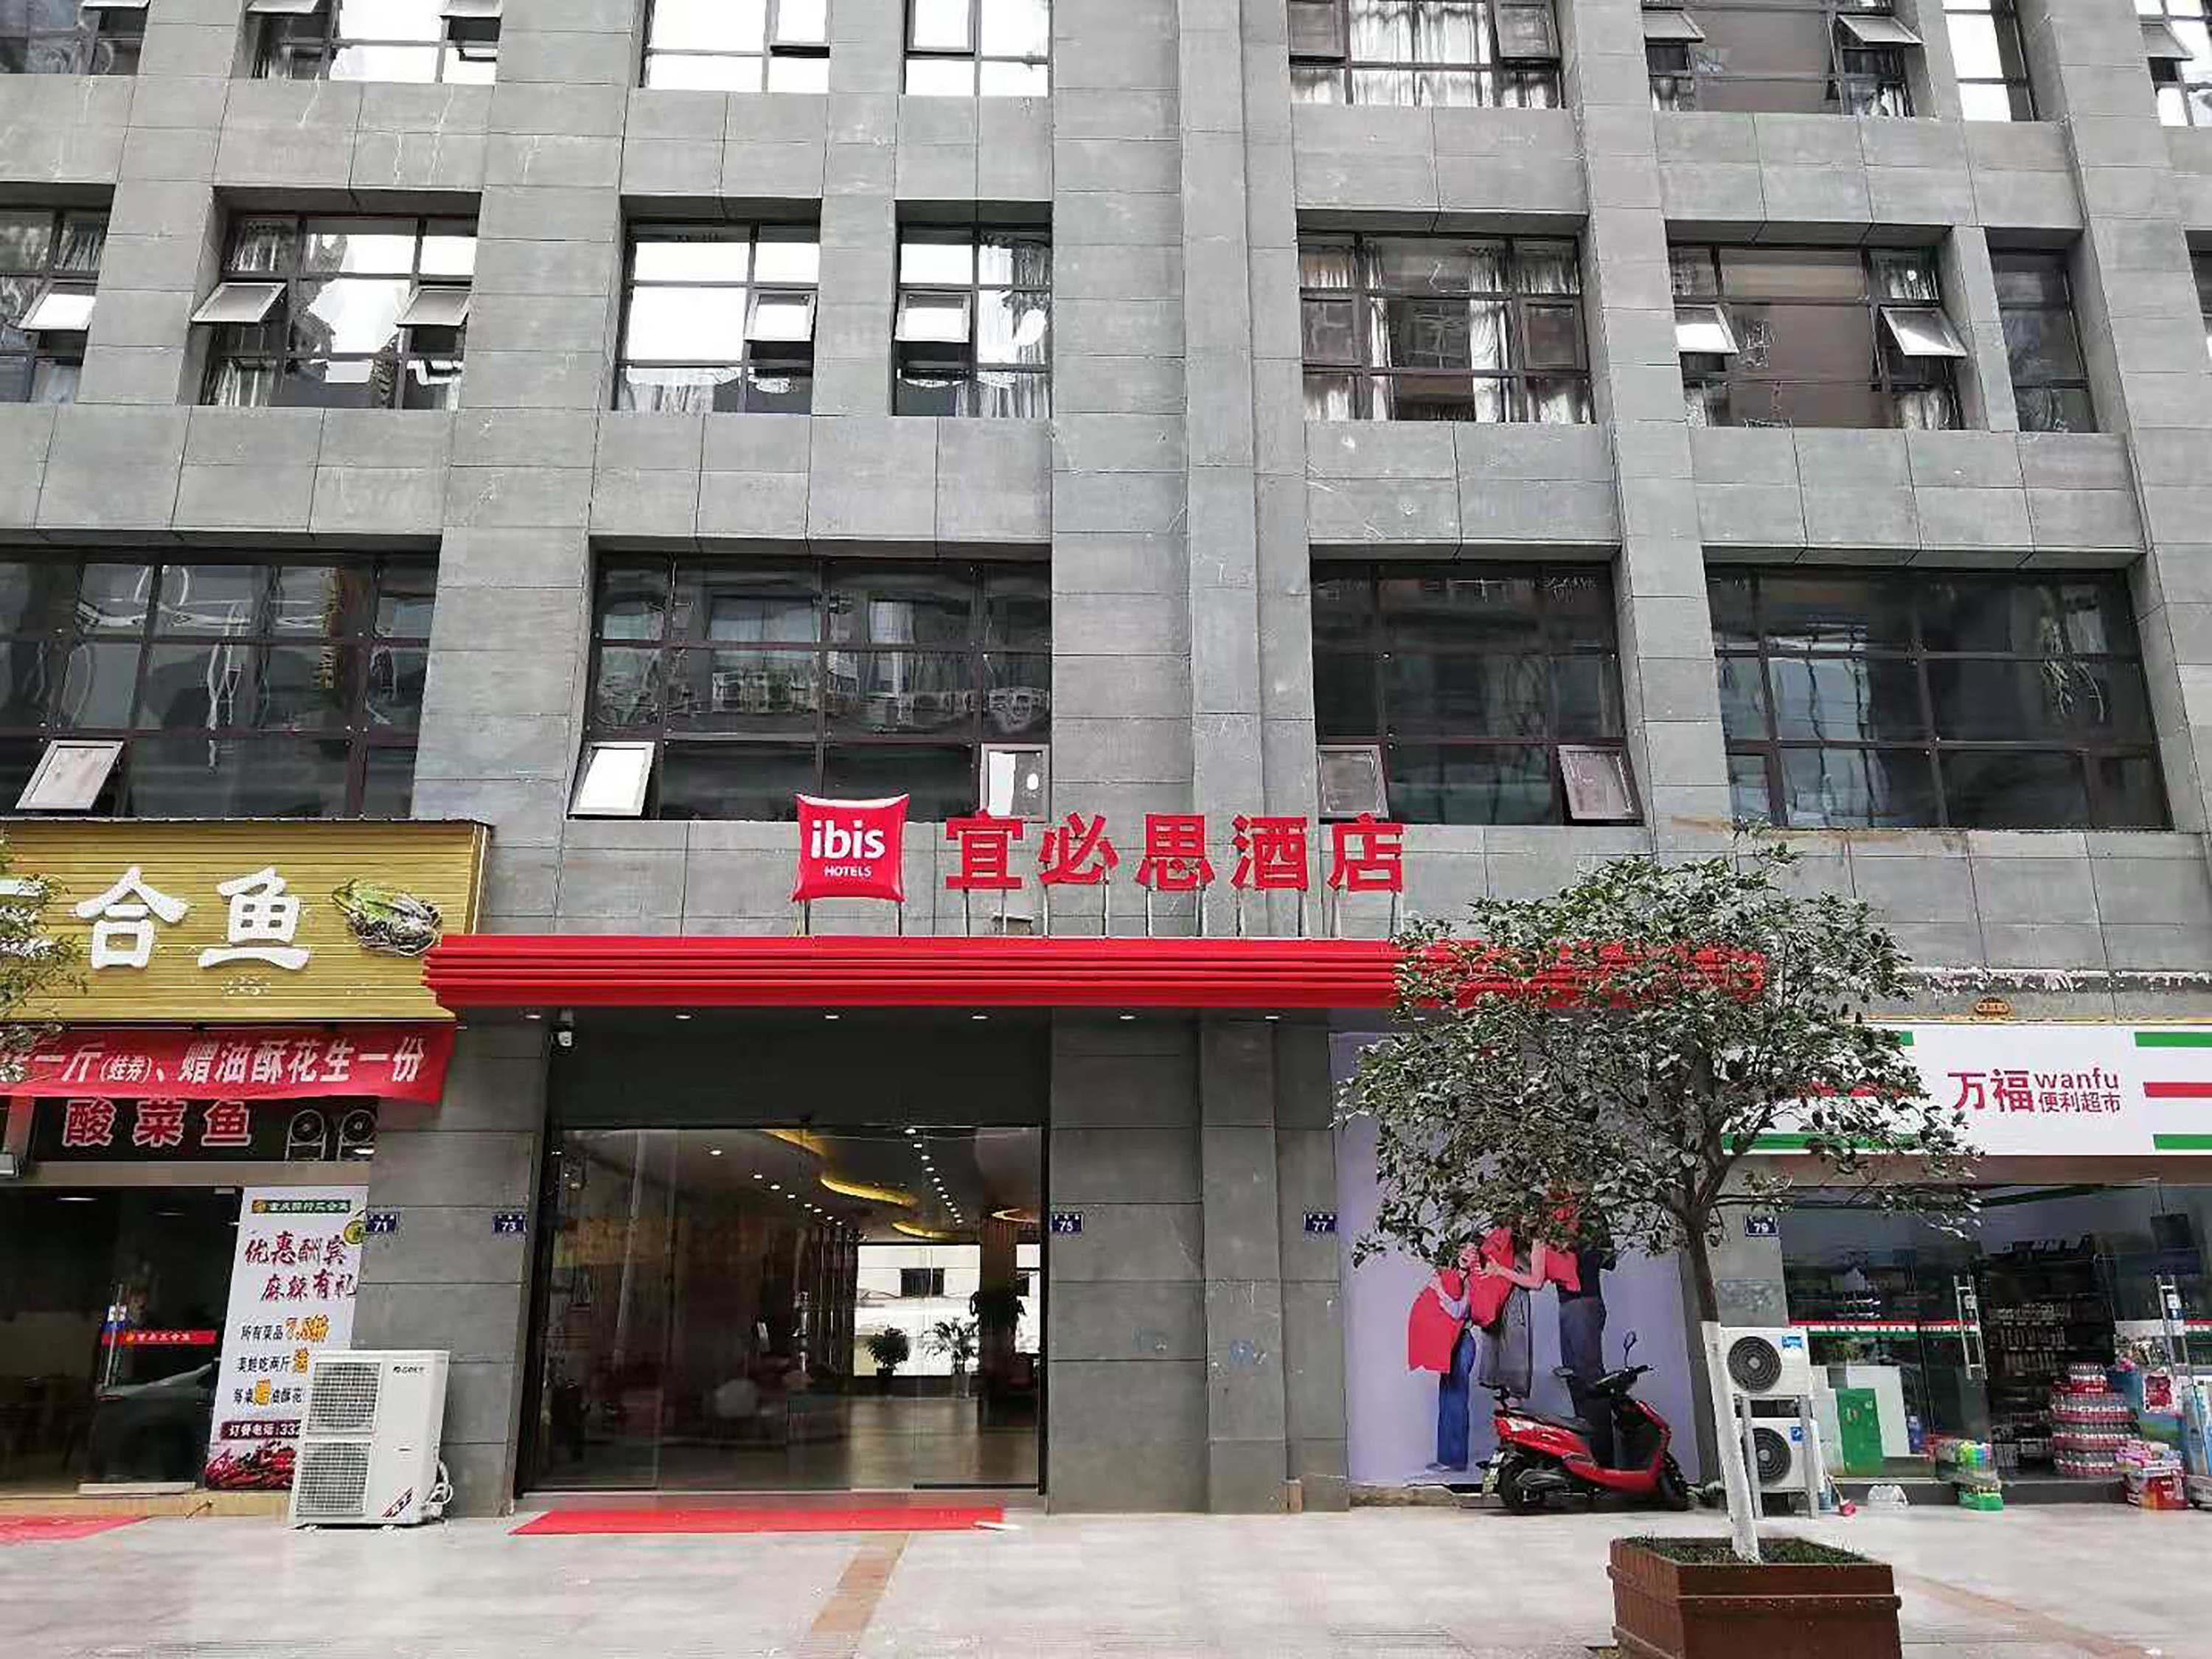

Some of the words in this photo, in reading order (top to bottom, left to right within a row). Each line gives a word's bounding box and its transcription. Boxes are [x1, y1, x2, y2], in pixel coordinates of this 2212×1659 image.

[810, 819, 885, 860] ibis
[946, 808, 1403, 891] 宜必思酒店
[824, 865, 872, 877] HOTELS
[2034, 1068, 2119, 1089] wanfu
[1947, 1068, 2035, 1113] 万福
[2038, 1091, 2121, 1113] 便利超市
[61, 1096, 251, 1147] 酸菜鱼
[374, 1220, 388, 1233] 71
[501, 1221, 517, 1232] 73
[1312, 1220, 1328, 1232] 77
[1753, 1222, 1770, 1233] 79
[245, 1231, 347, 1265] 优惠酬宾
[261, 1268, 357, 1302] 麻辣有礼
